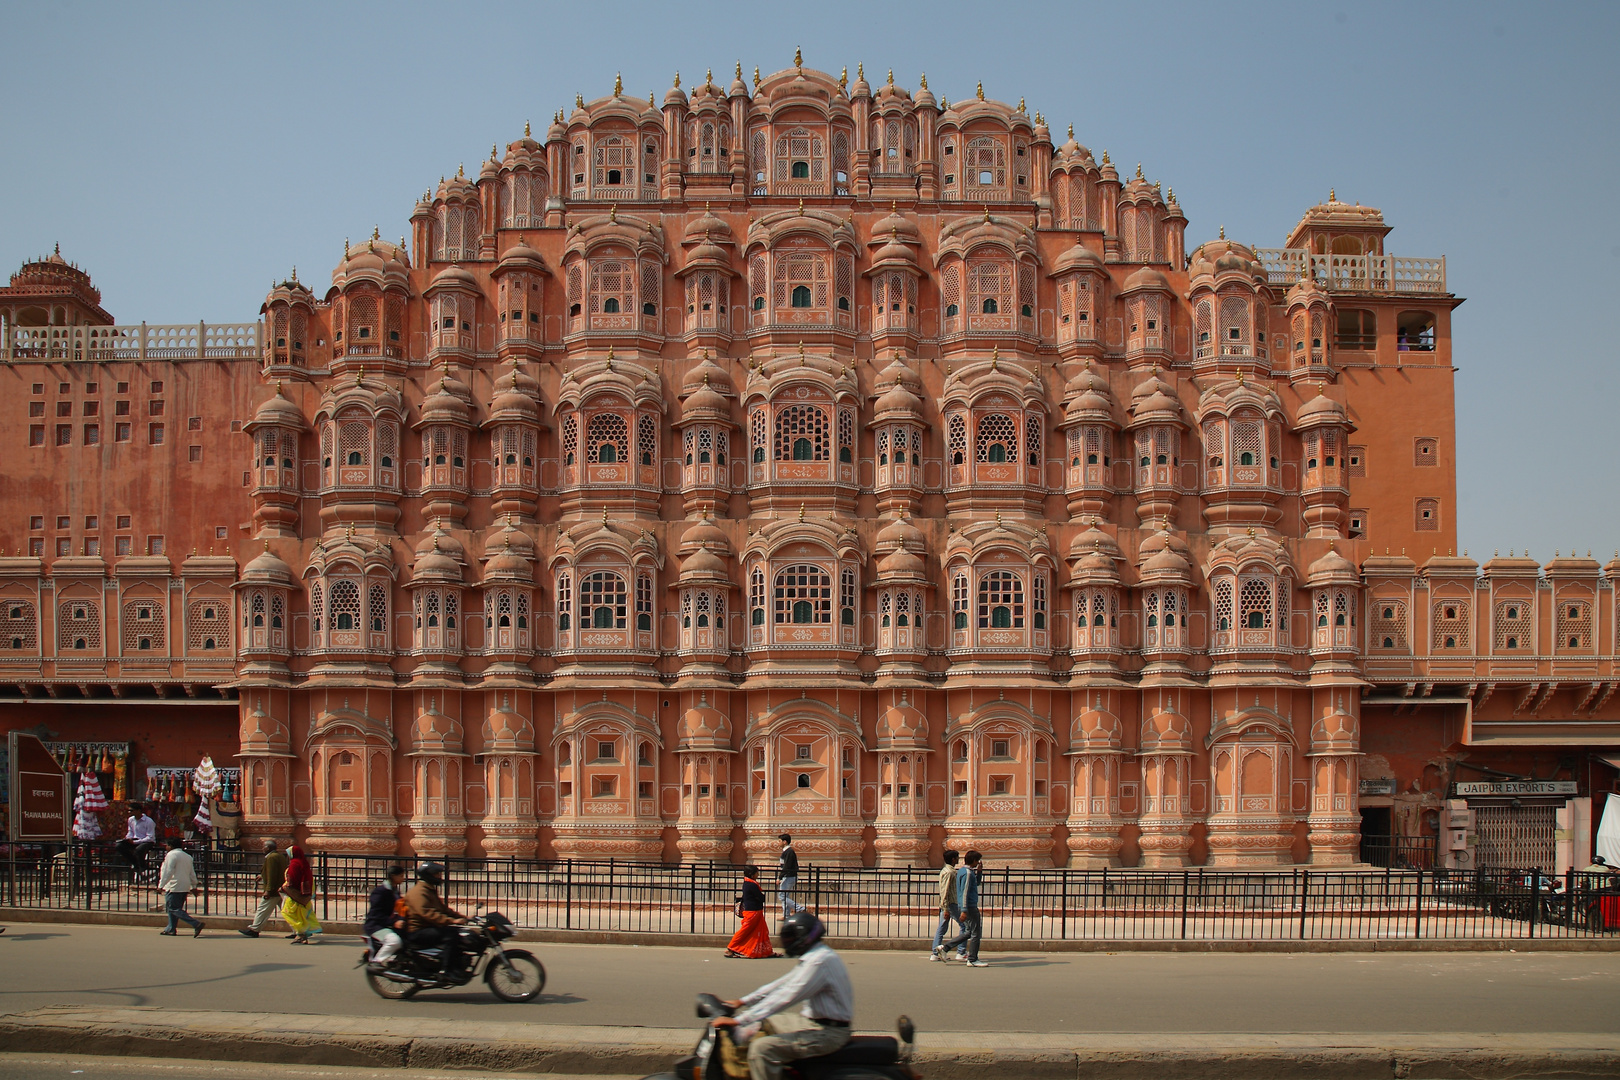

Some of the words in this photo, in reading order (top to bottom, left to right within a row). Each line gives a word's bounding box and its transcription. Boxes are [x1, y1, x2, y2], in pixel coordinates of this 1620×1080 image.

[90, 743, 126, 752] EMPORIUM
[1464, 784, 1502, 793] JAIPUR
[1506, 783, 1556, 793] EXPORT'S
